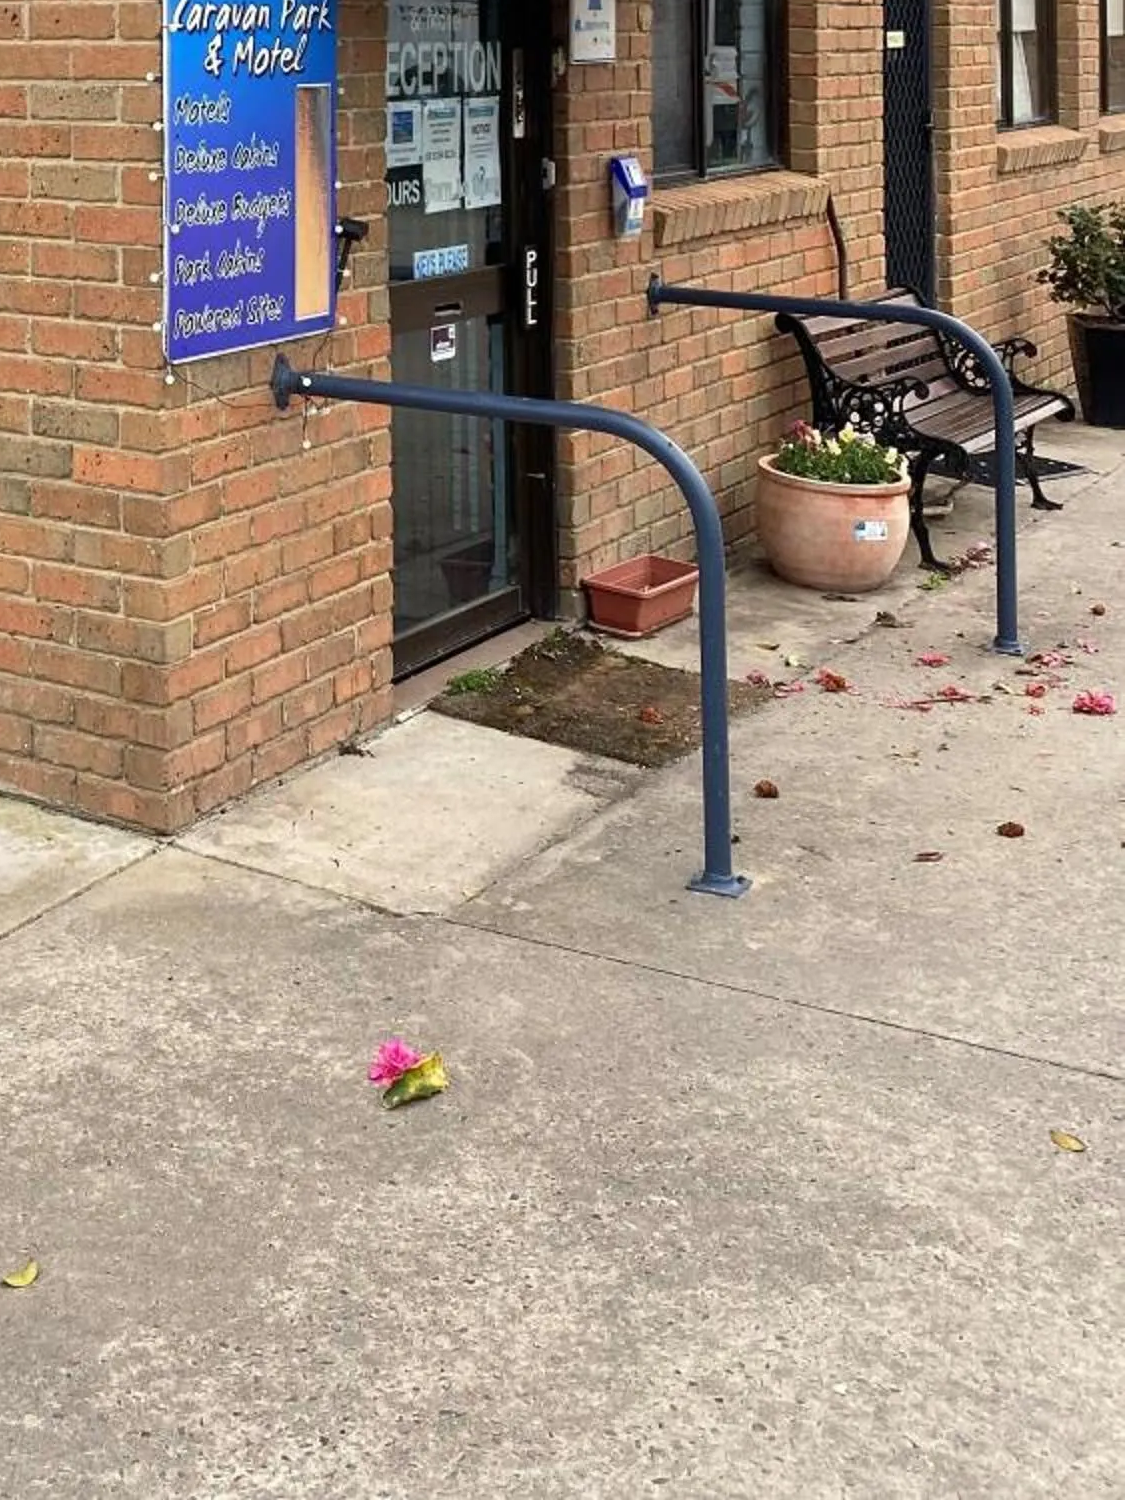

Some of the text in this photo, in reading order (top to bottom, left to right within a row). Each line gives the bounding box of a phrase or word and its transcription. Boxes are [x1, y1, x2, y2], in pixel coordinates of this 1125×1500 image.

[203, 33, 308, 77] & Motel
[385, 40, 502, 96] ECEPTION
[175, 139, 228, 175] Deluxe
[175, 192, 228, 226] Deluxe
[387, 180, 420, 206] URS
[174, 250, 214, 287] Park
[525, 249, 538, 326] PULL
[173, 293, 286, 340] Powered Sites
